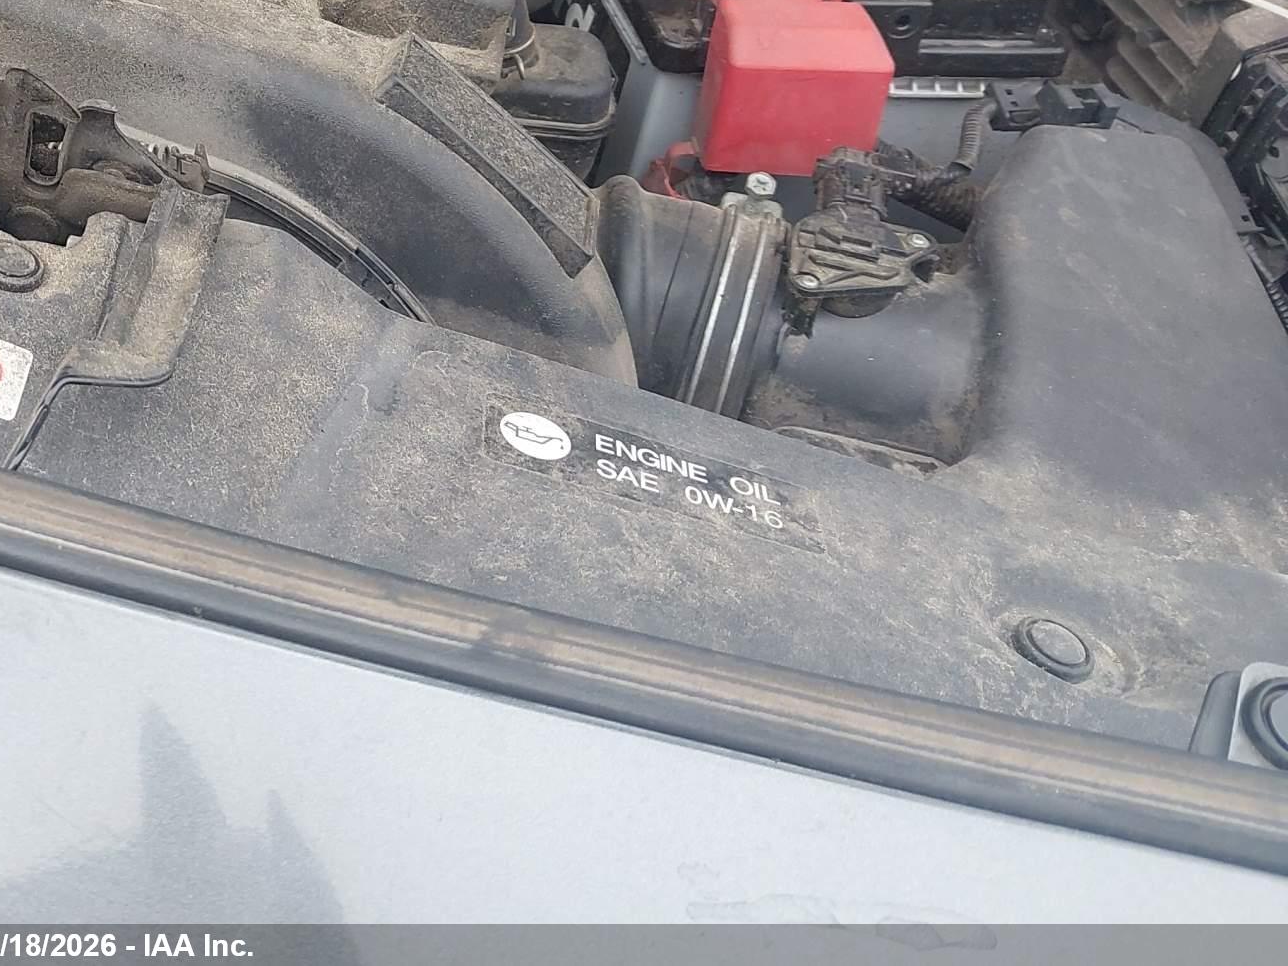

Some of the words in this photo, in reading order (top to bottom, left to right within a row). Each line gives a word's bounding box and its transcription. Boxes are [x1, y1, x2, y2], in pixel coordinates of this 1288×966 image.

[595, 433, 709, 484] ENGINE
[729, 476, 782, 506] OIL
[596, 458, 660, 494] SAE
[684, 485, 784, 529] 0W-16
